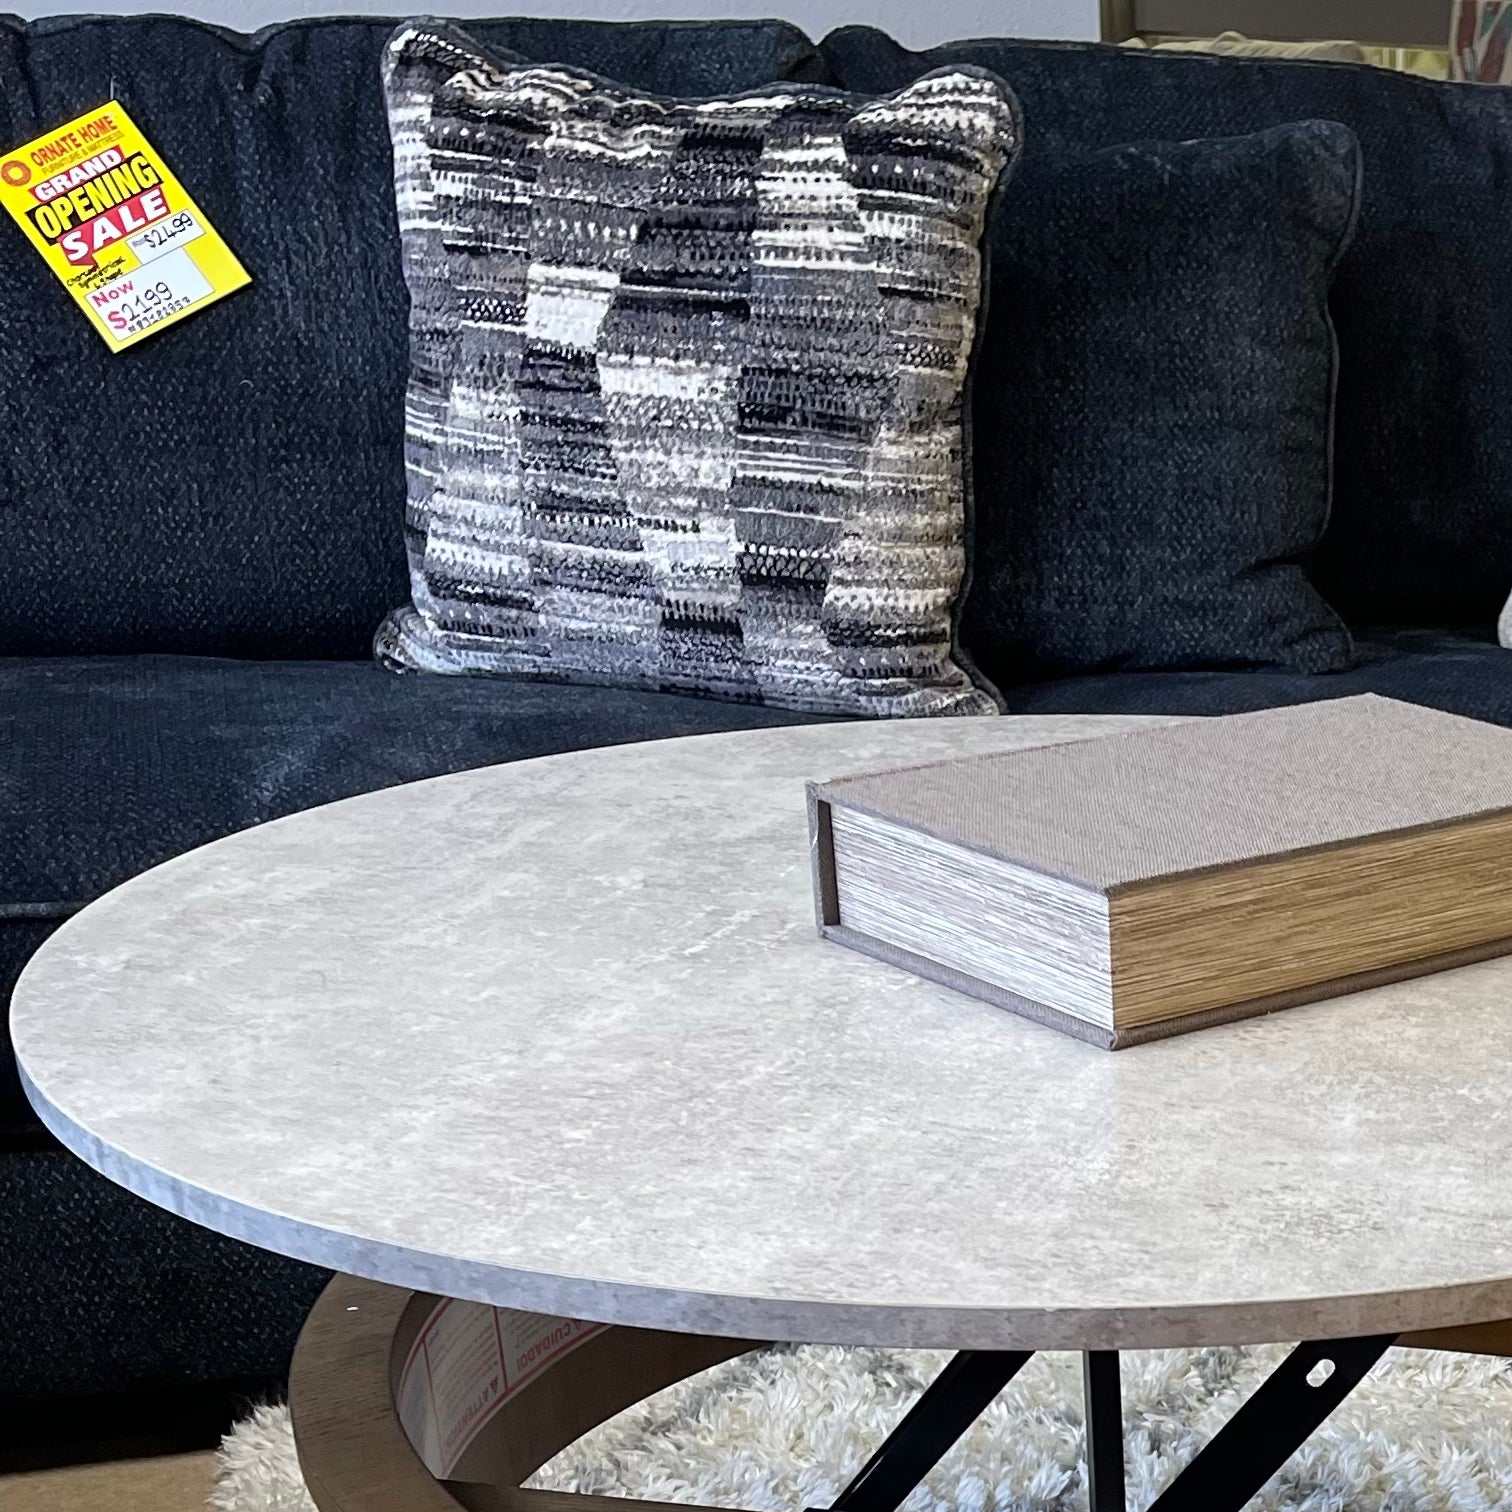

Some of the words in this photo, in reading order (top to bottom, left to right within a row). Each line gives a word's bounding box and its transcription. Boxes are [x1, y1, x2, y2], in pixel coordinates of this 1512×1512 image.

[31, 133, 80, 166] ORNATE
[80, 115, 117, 141] HOME
[34, 154, 160, 240] OPENING
[35, 149, 123, 202] GRAND
[61, 190, 168, 262] SALE
